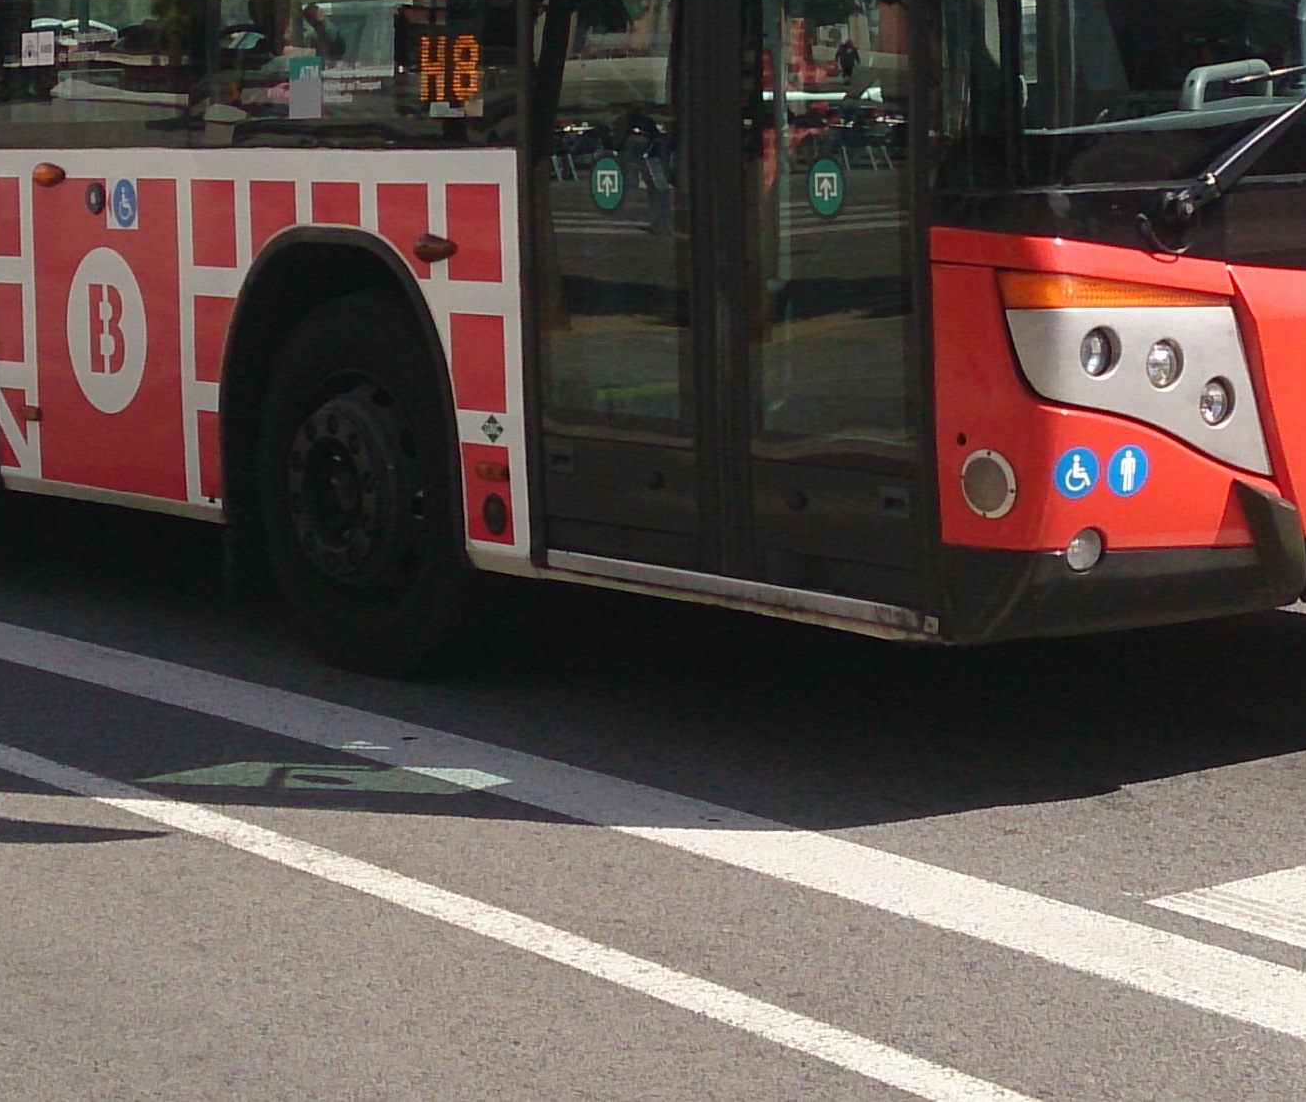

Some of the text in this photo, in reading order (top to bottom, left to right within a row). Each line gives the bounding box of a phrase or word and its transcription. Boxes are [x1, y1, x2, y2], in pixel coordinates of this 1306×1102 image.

[299, 64, 319, 82] ATM
[420, 35, 480, 101] H8
[88, 284, 126, 375] B
